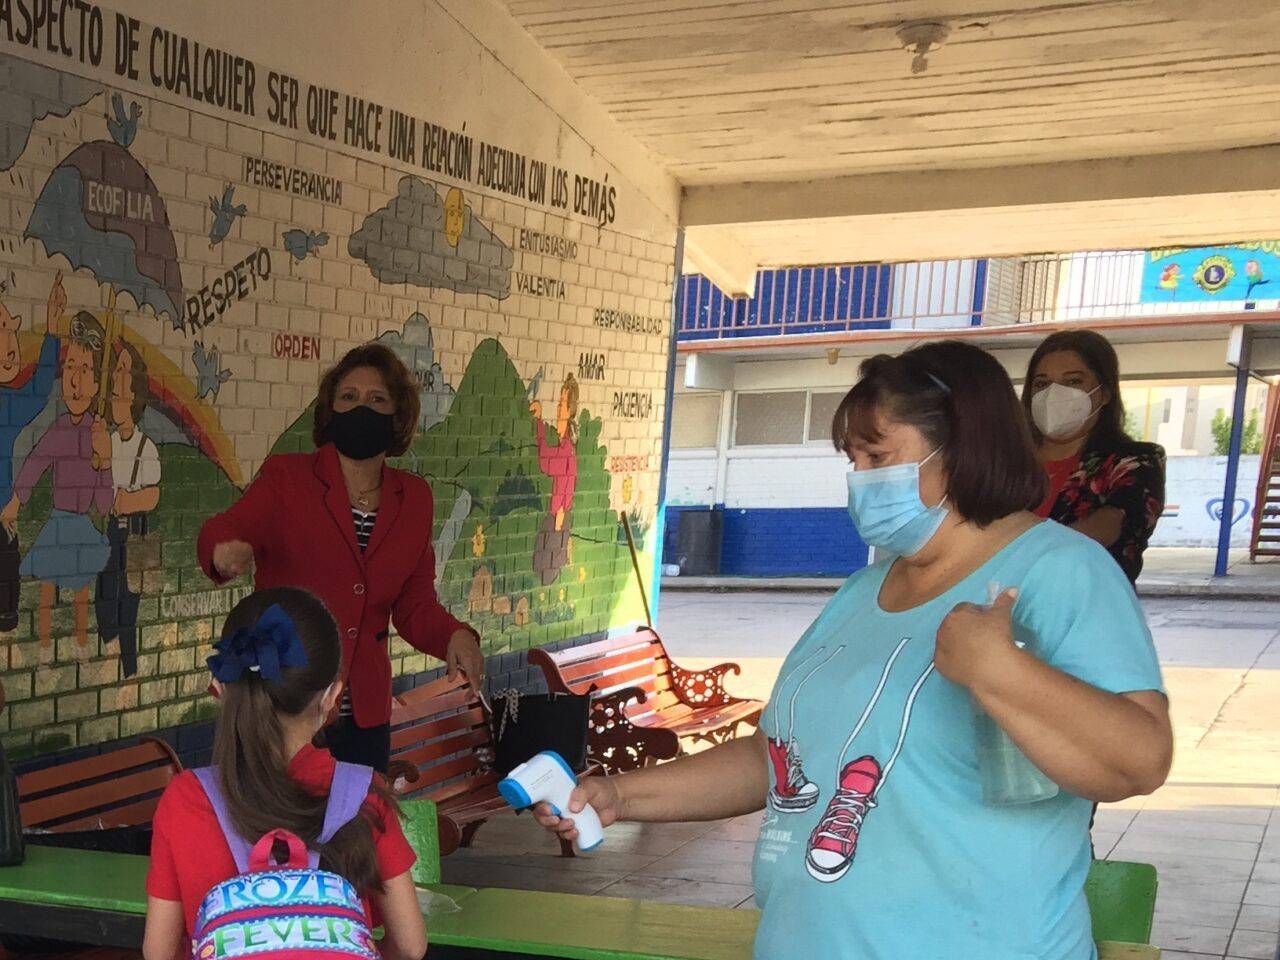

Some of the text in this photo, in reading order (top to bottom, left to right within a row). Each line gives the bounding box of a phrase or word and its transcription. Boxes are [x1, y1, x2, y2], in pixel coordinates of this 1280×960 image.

[115, 13, 140, 80] DE
[149, 26, 256, 116] CUALQUIER
[267, 71, 299, 130] SER
[306, 84, 339, 141] QUE
[344, 95, 383, 153] HACE
[388, 109, 416, 165] UNA
[422, 121, 473, 182] RELACIÓN
[477, 142, 526, 199] ADECUADA
[528, 159, 547, 205] CON
[551, 165, 568, 209] LOS
[574, 173, 617, 227] DEMÁS
[245, 156, 342, 206] PERSEVERANCIA
[87, 181, 155, 223] ECOFILIA
[187, 247, 271, 335] RESPETO
[592, 307, 663, 336] RESPONSABILIDAD
[273, 333, 321, 361] ORDEN
[577, 352, 605, 381] AMAR
[612, 391, 653, 419] PACIENCIA
[214, 917, 363, 957] FEVER
